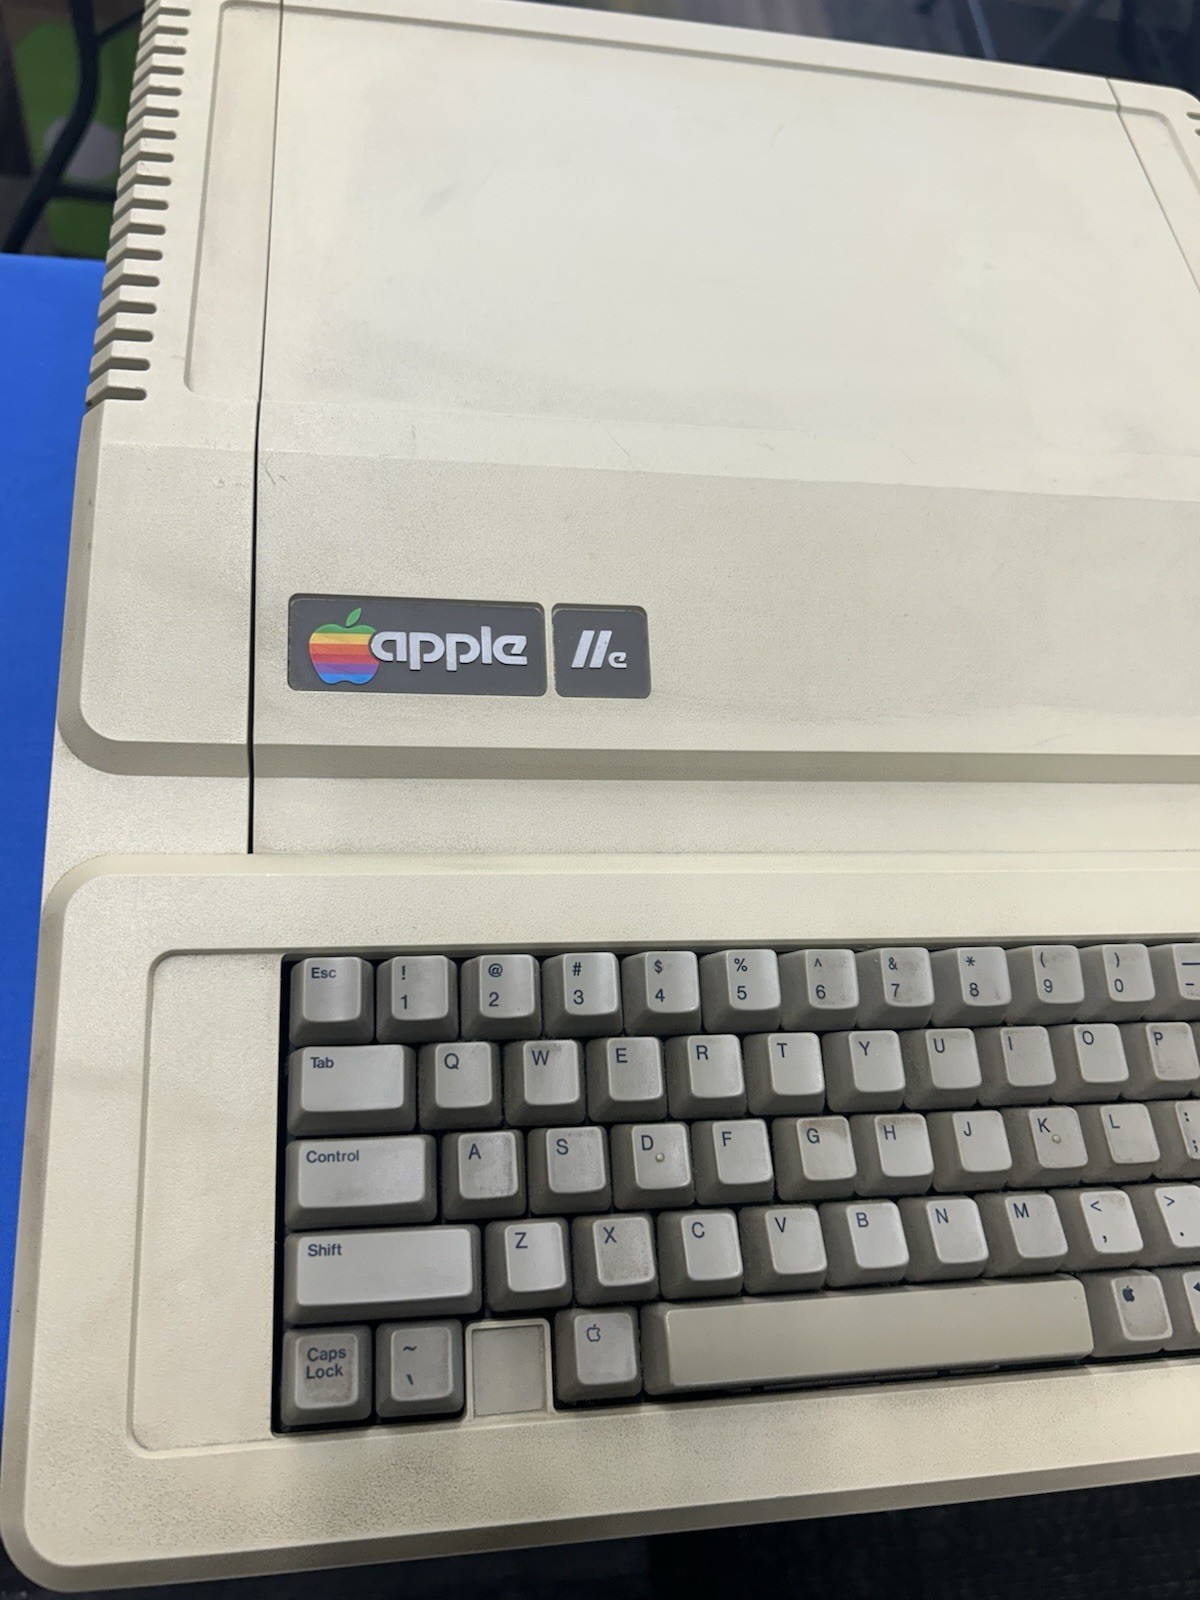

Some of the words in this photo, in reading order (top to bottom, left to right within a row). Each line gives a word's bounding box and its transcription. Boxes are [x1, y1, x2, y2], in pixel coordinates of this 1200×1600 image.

[370, 625, 528, 671] apple
[654, 959, 663, 975] $
[733, 957, 748, 972] %
[888, 957, 898, 970] &
[1040, 952, 1046, 968] (
[1114, 952, 1120, 968] )
[311, 967, 337, 979] Esc
[402, 965, 407, 980] !
[488, 963, 503, 978] @
[572, 961, 582, 977] #
[737, 985, 747, 1001] 5
[815, 984, 826, 1000] 6
[891, 983, 900, 998] 7
[969, 982, 980, 997] 8
[1043, 978, 1053, 994] 9
[1114, 978, 1124, 993] 0
[400, 994, 408, 1010] 1
[488, 991, 499, 1007] 2
[573, 989, 584, 1005] 3
[654, 988, 665, 1002] 4
[933, 1038, 946, 1054] U
[1007, 1036, 1013, 1051] I
[1082, 1030, 1094, 1046] O
[1153, 1031, 1164, 1046] P
[615, 1047, 628, 1064] E
[696, 1045, 709, 1060] R
[776, 1042, 788, 1058] T
[858, 1040, 870, 1056] Y
[310, 1056, 334, 1069] Tab
[444, 1052, 459, 1070] Q
[531, 1049, 550, 1066] W
[1037, 1117, 1051, 1133] K
[1108, 1114, 1121, 1129] L
[1183, 1112, 1190, 1122] :
[806, 1127, 820, 1144] G
[882, 1124, 897, 1140] H
[963, 1121, 972, 1137] J
[556, 1138, 569, 1155] S
[641, 1134, 654, 1151] D
[721, 1131, 732, 1147] F
[1191, 1138, 1199, 1153] ;
[306, 1149, 360, 1164] Control
[468, 1143, 482, 1160] A
[1090, 1200, 1102, 1212] <
[1164, 1196, 1175, 1207] >
[935, 1208, 949, 1224] N
[1013, 1202, 1030, 1218] M
[774, 1217, 787, 1233] V
[855, 1212, 869, 1228] B
[603, 1226, 617, 1244] X
[691, 1221, 705, 1239] C
[514, 1231, 528, 1249] Z
[308, 1243, 342, 1257] Shift
[306, 1347, 347, 1363] Caps
[306, 1363, 344, 1380] Lock
